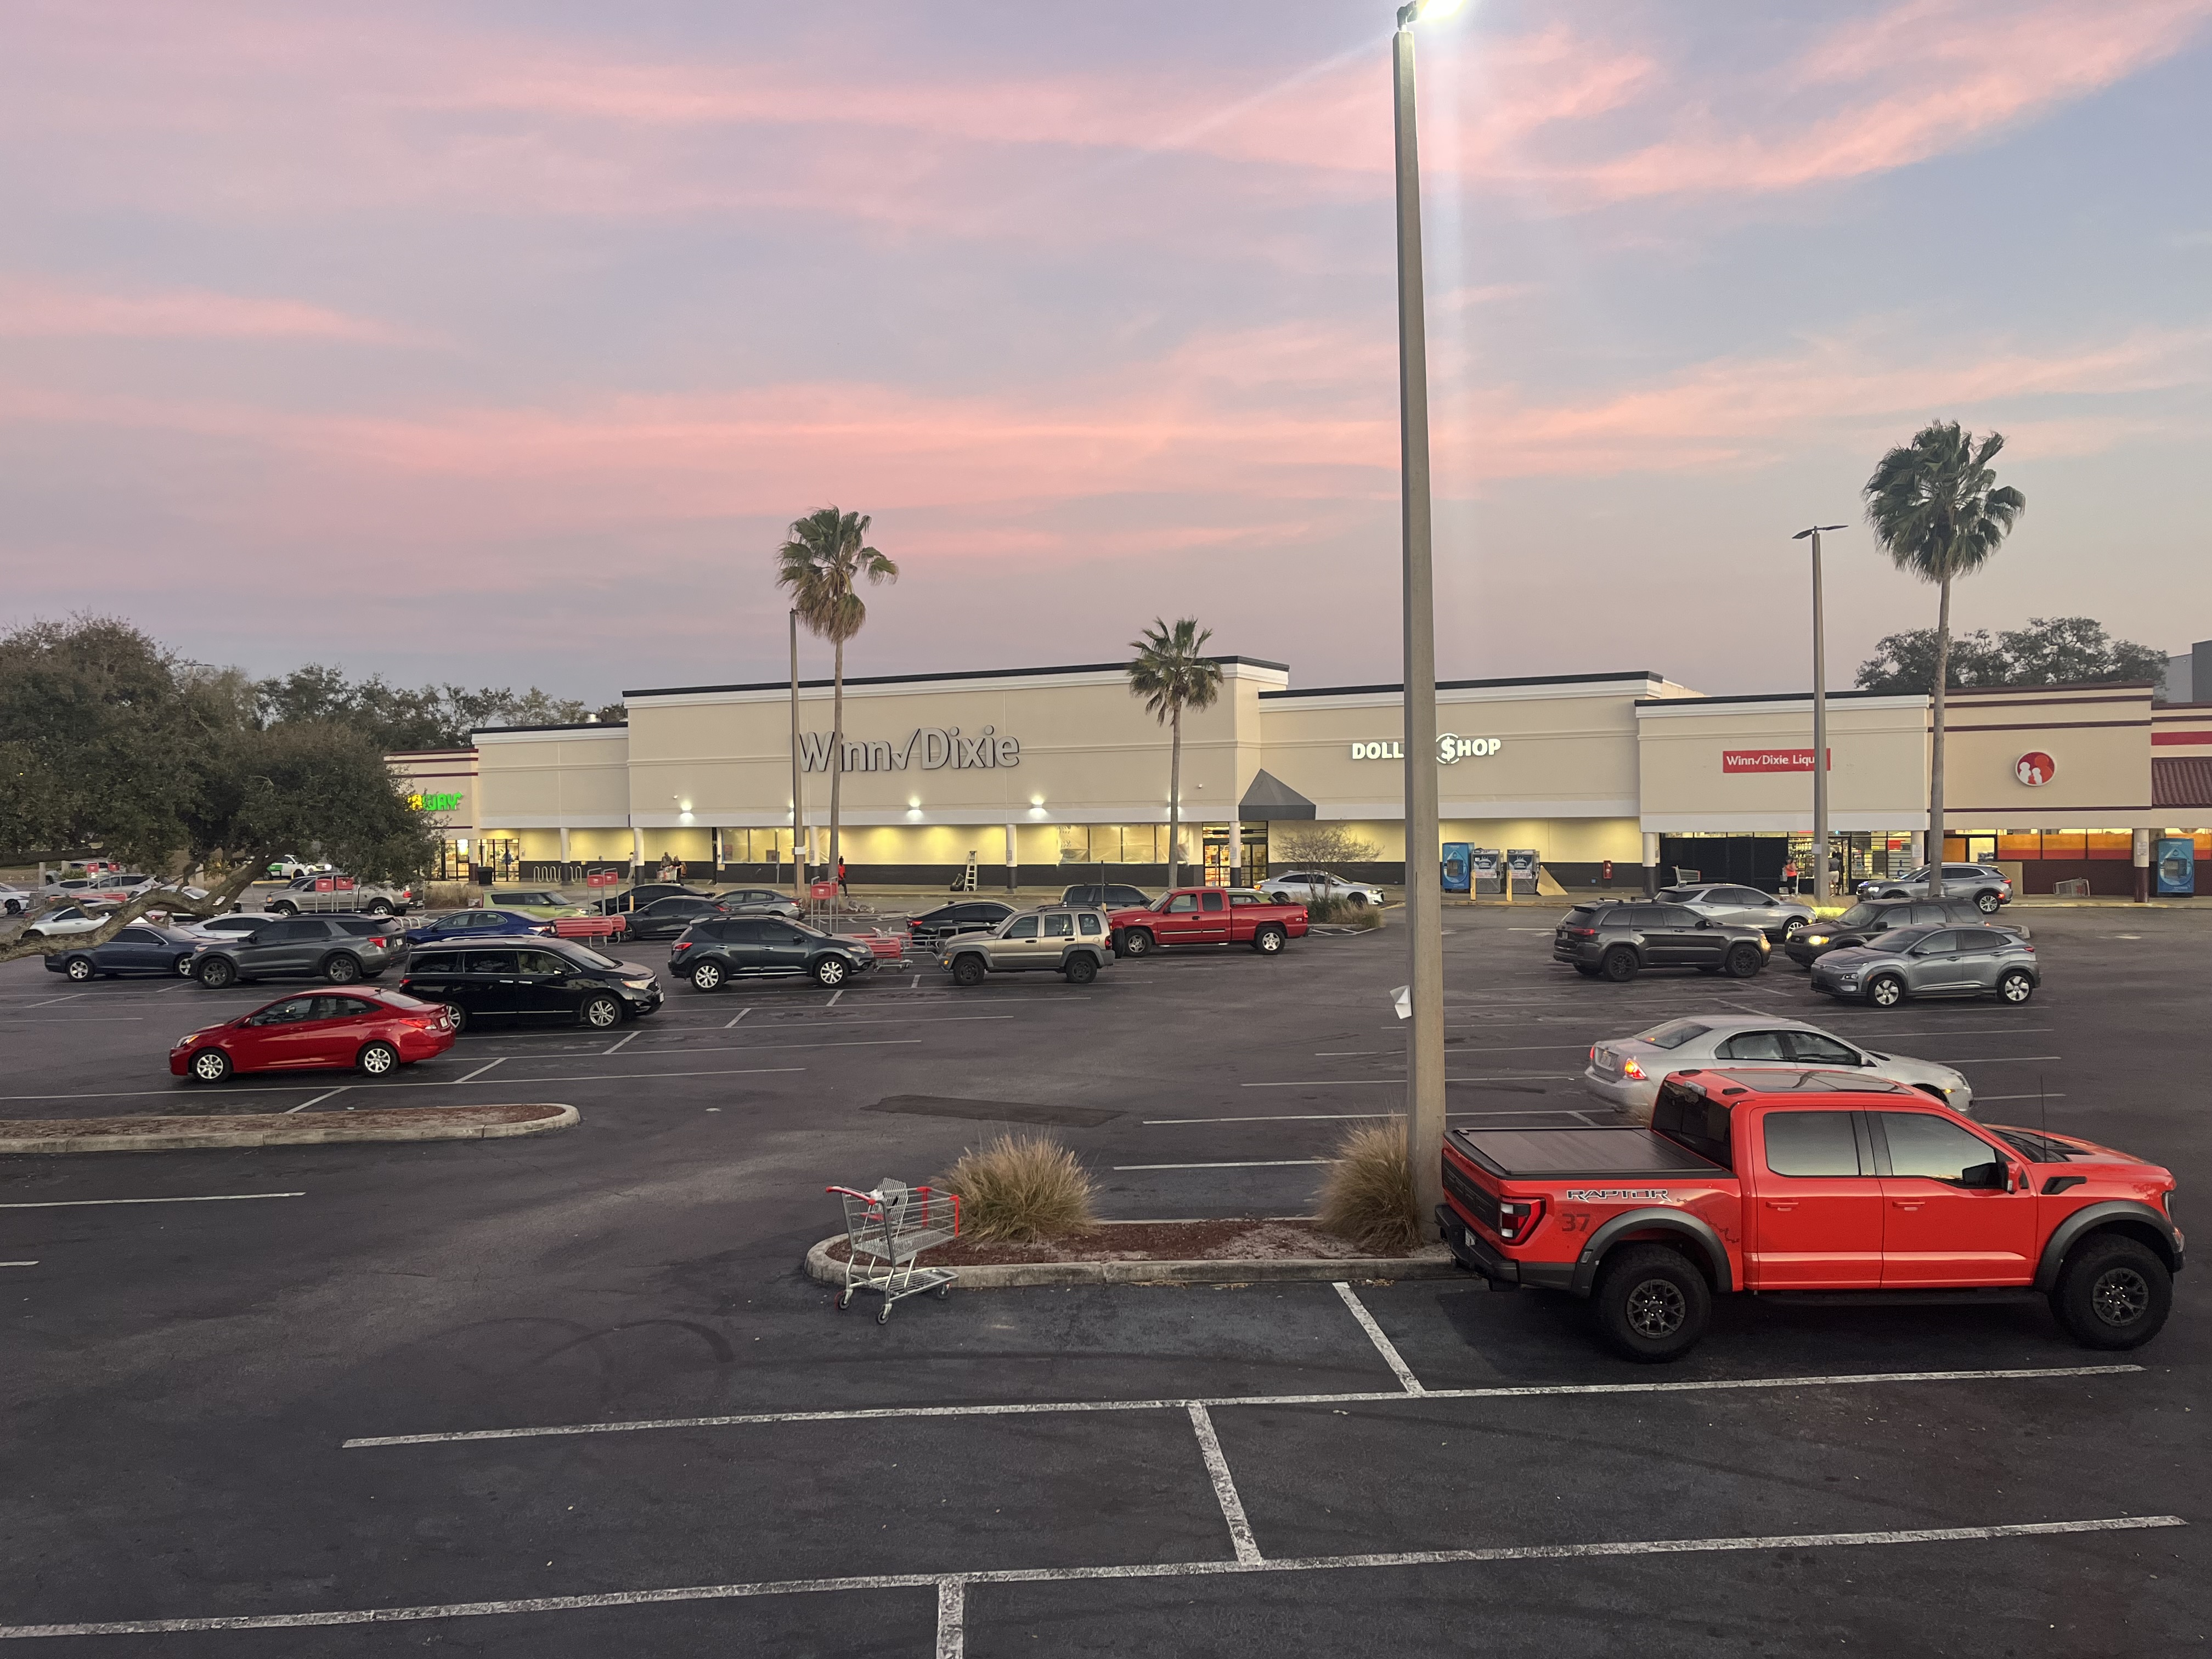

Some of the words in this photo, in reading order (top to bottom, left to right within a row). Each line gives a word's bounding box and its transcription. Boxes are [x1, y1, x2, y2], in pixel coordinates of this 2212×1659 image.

[799, 731, 891, 772] Wnn
[921, 725, 1019, 769] Dixie
[1352, 742, 1404, 759] DOLL
[1441, 736, 1502, 761] $HOP
[1726, 755, 1755, 765] Winn
[1762, 754, 1788, 765] Dixie
[1793, 754, 1815, 766] Liqu
[408, 792, 463, 811] BWAY
[1567, 1189, 1673, 1204] RAPTOR
[1562, 1214, 1590, 1232] 37
